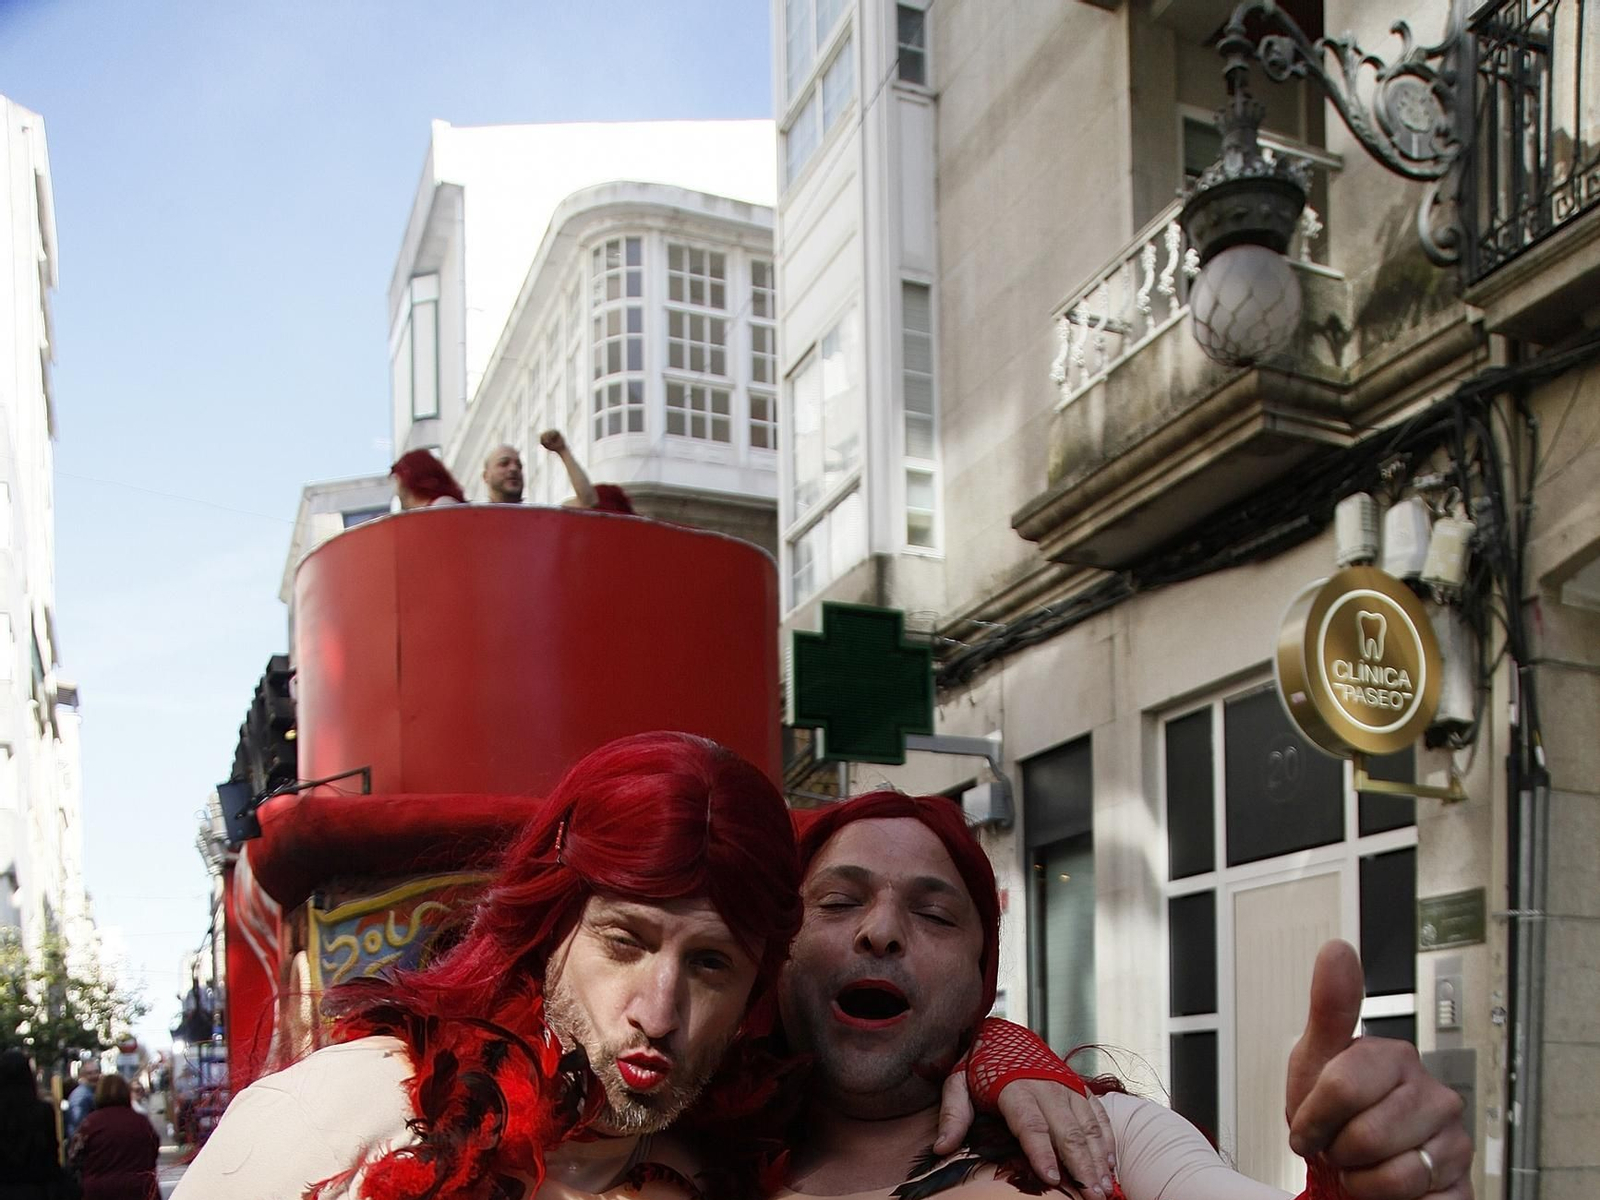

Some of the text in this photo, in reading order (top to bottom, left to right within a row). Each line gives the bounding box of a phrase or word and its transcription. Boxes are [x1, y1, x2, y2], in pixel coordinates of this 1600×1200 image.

[1332, 659, 1412, 690] CLÍNICA
[1343, 684, 1404, 711] PASEO
[1268, 746, 1299, 788] 20
